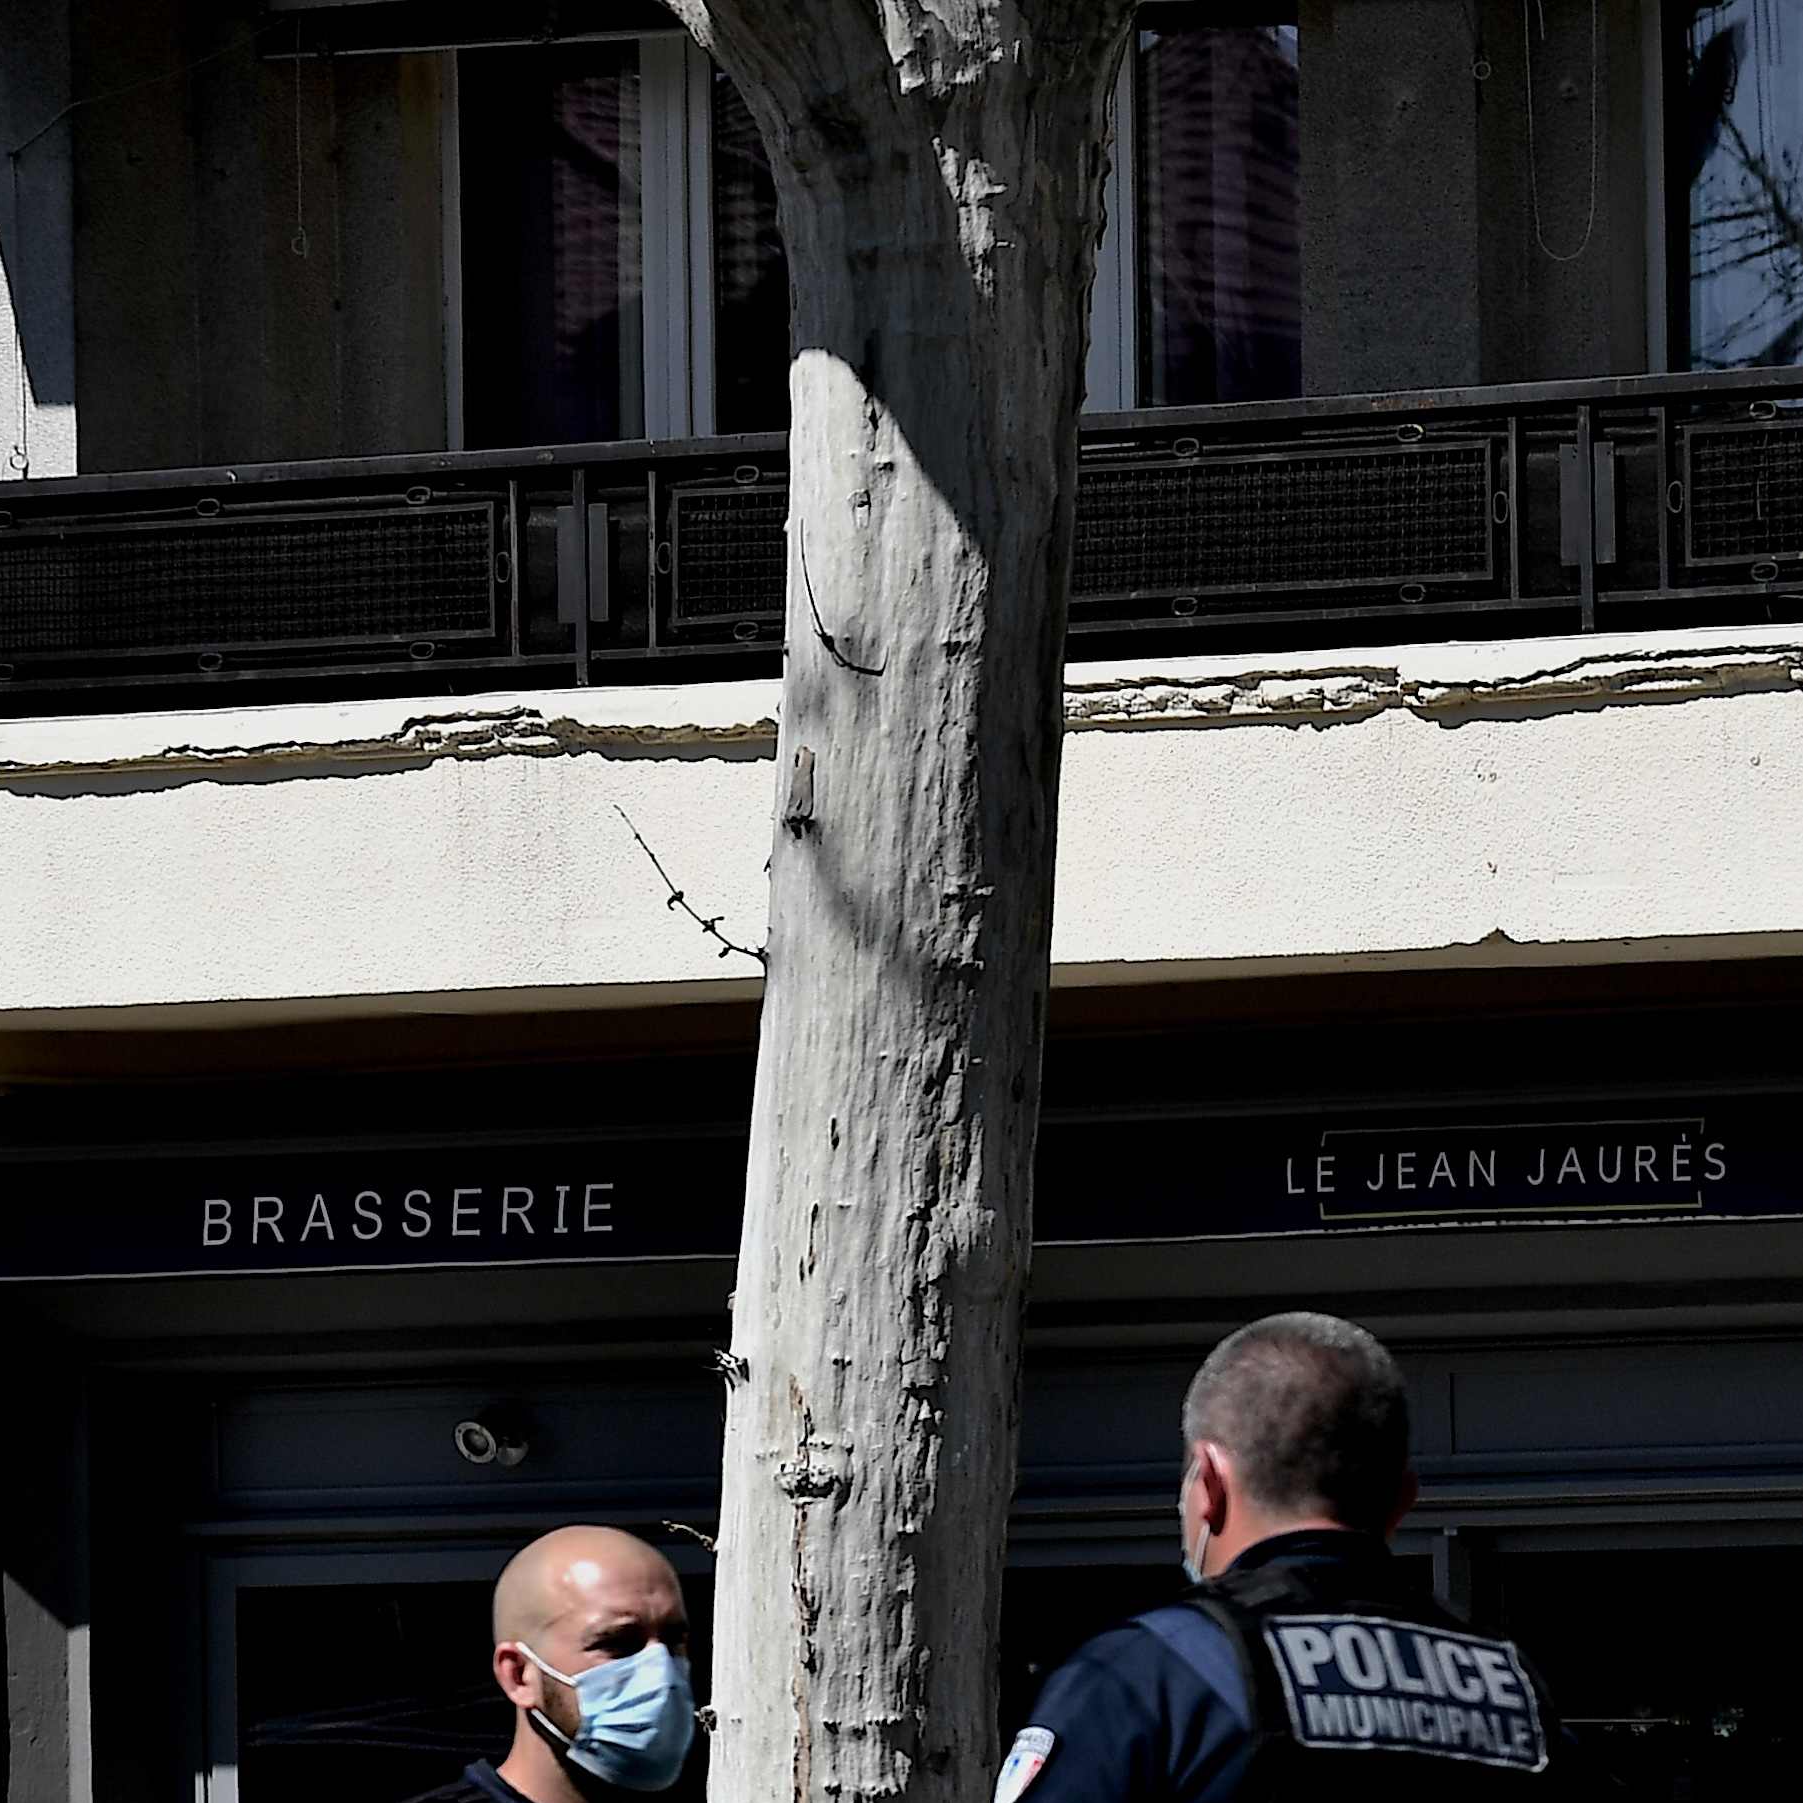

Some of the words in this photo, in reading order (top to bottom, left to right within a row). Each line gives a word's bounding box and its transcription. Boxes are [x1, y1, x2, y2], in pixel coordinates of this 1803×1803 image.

[1286, 1155, 1336, 1195] LE
[1365, 1149, 1497, 1193] JEAN
[202, 1182, 615, 1248] BRASSERIE
[1278, 1624, 1528, 1710] POLICE
[1300, 1692, 1534, 1758] MUNICIPALE
